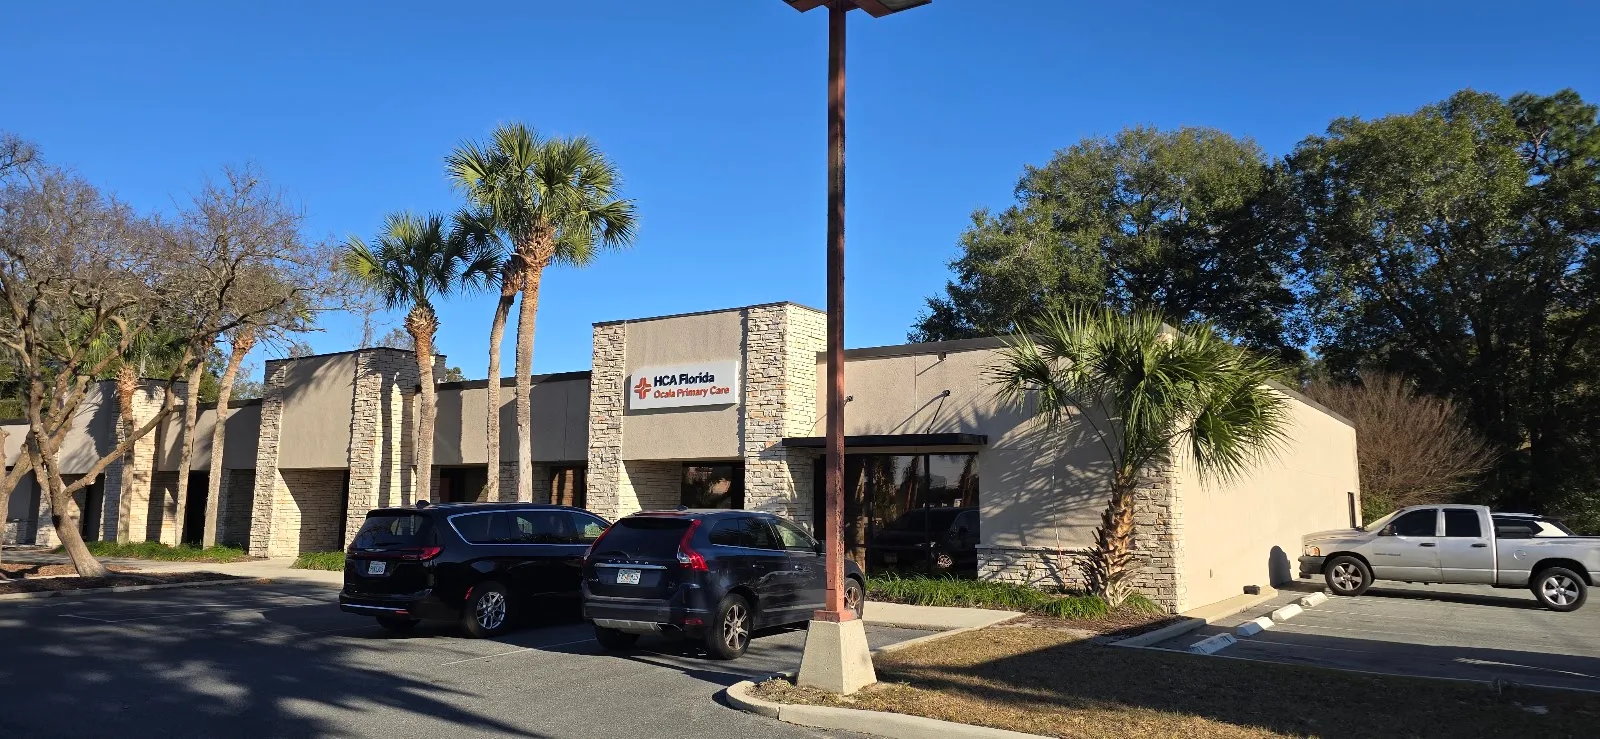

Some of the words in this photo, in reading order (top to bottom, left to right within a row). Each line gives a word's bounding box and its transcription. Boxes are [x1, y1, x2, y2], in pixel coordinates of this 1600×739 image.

[654, 375, 677, 387] HCA
[679, 372, 715, 385] Florida
[654, 389, 675, 399] Ocala
[677, 387, 708, 398] Primary
[710, 386, 730, 395] Care
